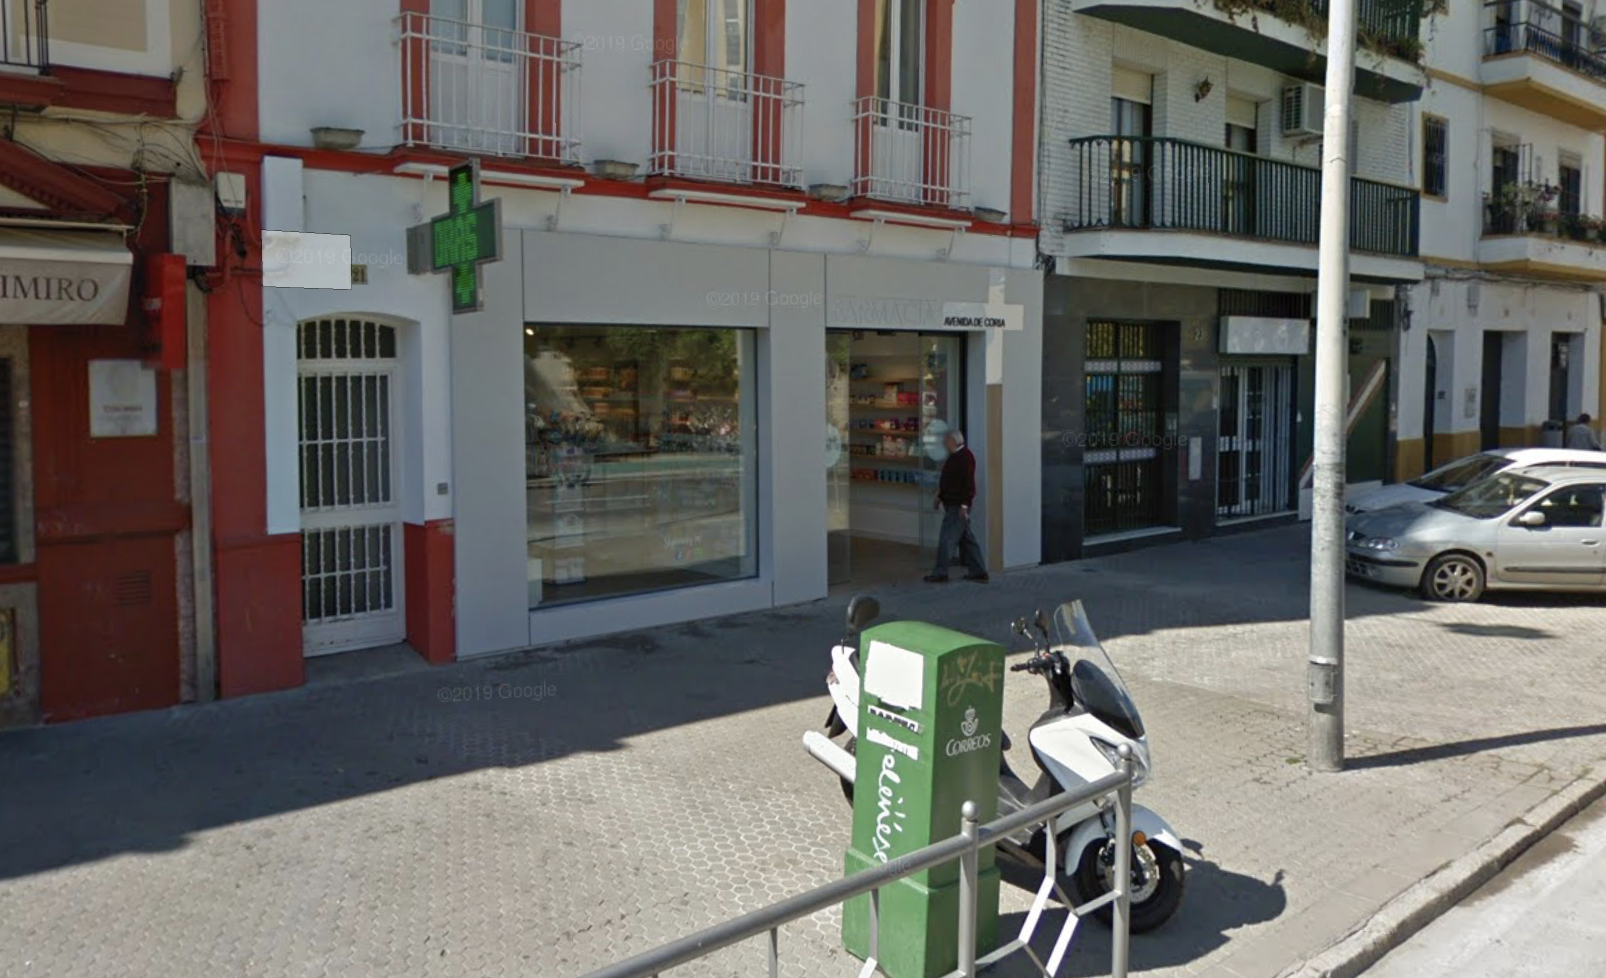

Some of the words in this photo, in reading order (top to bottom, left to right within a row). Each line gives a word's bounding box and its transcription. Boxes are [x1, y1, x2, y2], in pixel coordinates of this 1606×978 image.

[0, 275, 99, 302] IMIRO
[944, 317, 973, 326] AVENIDA
[974, 317, 983, 327] DE
[984, 318, 1005, 327] CORIA
[946, 733, 992, 757] CORREOS
